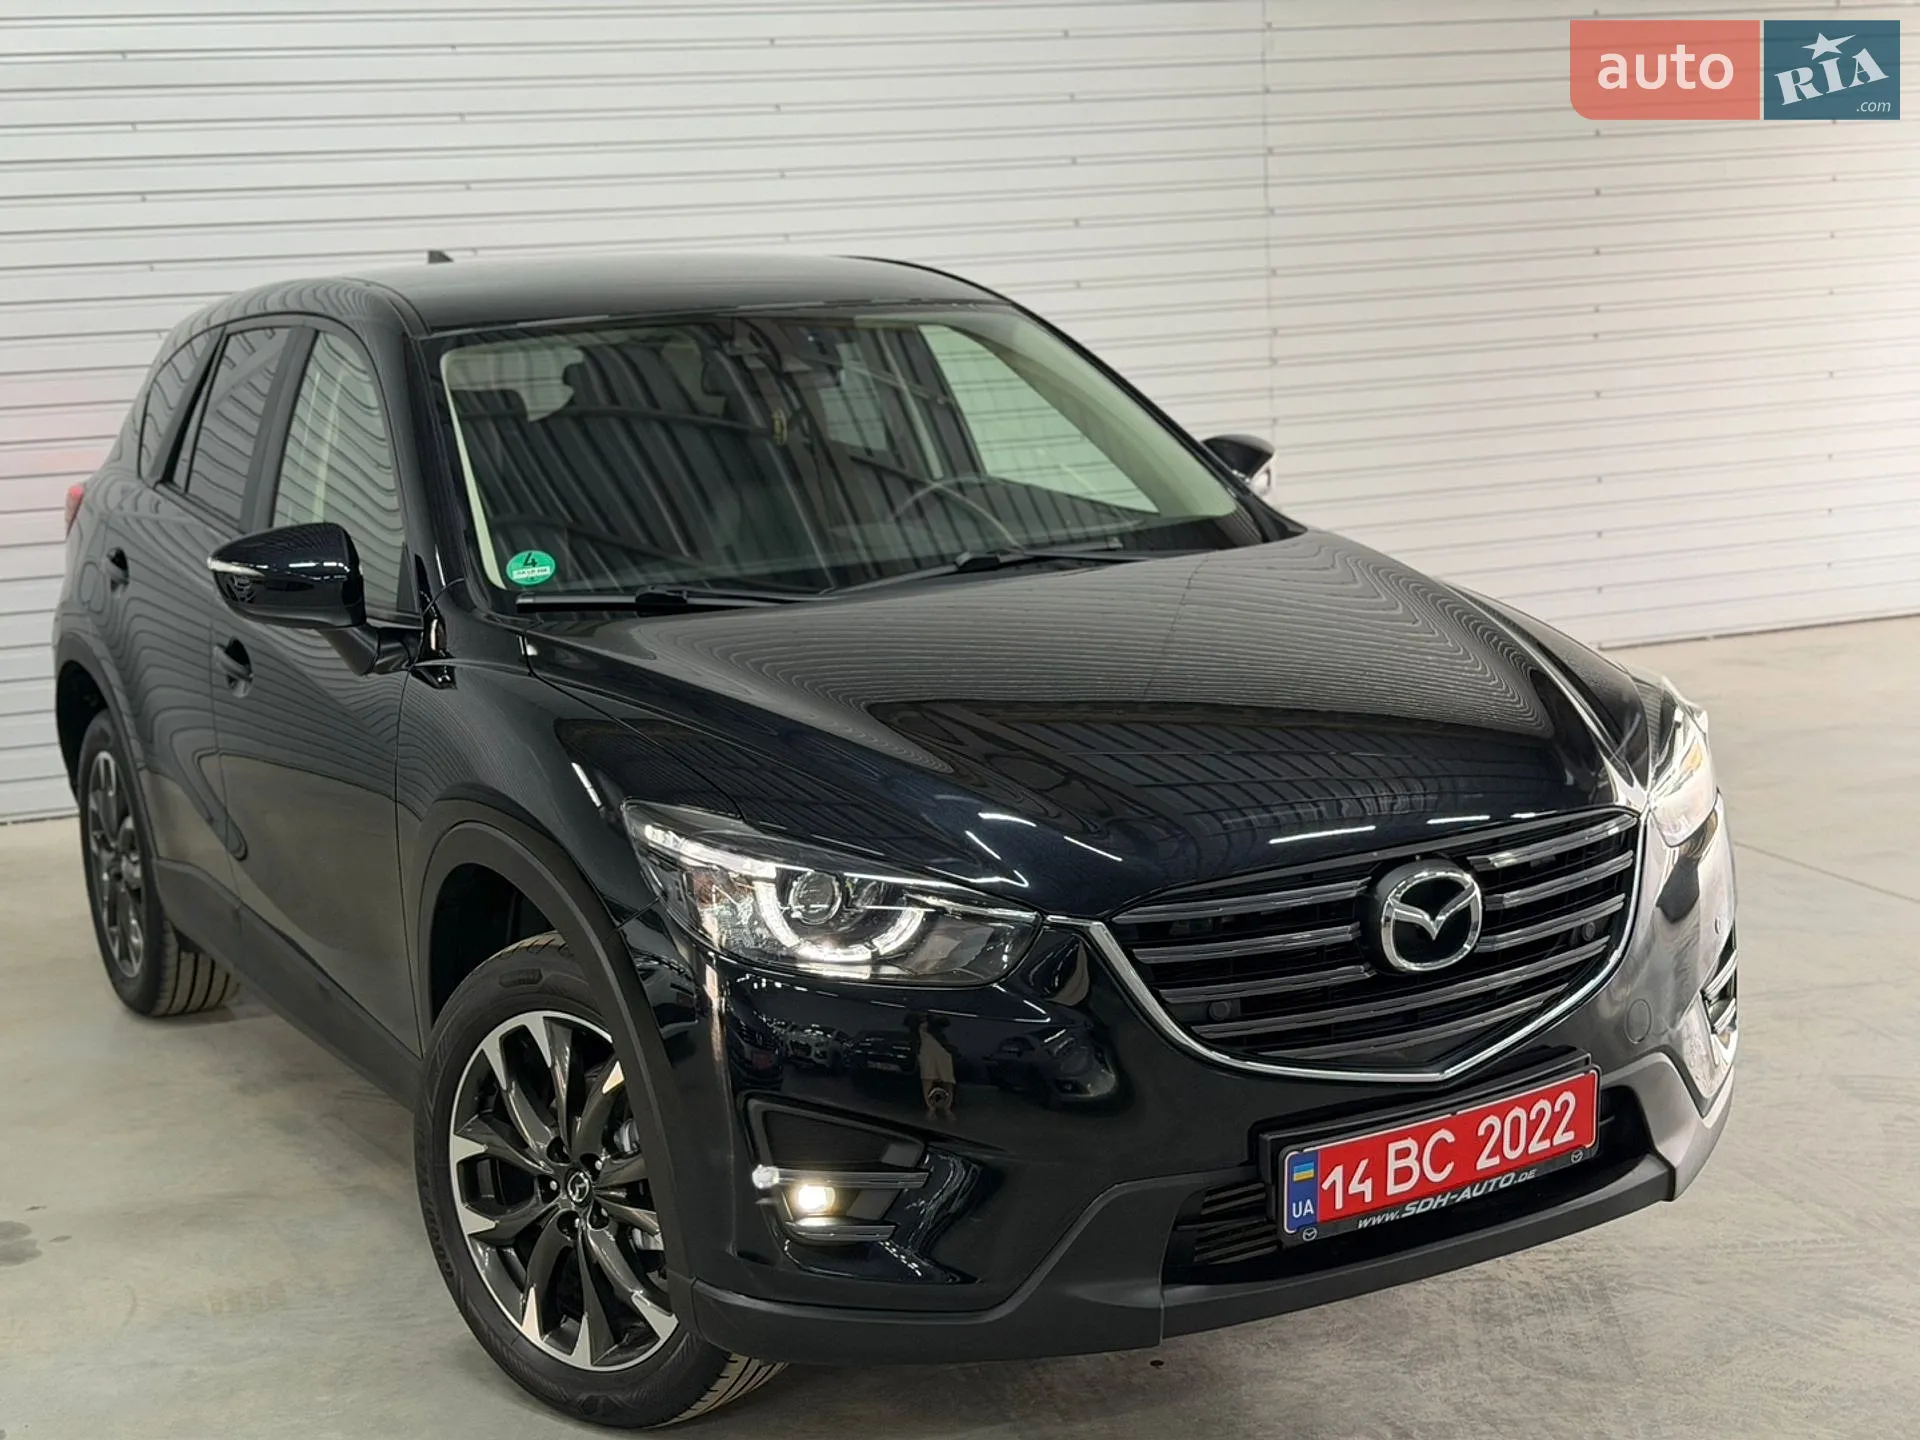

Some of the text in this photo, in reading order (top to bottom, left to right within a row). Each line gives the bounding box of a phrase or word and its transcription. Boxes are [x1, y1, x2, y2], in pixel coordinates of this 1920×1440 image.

[523, 552, 537, 567] 4
[1321, 1091, 1577, 1211] 14 BC 2022
[1292, 1199, 1315, 1219] UA
